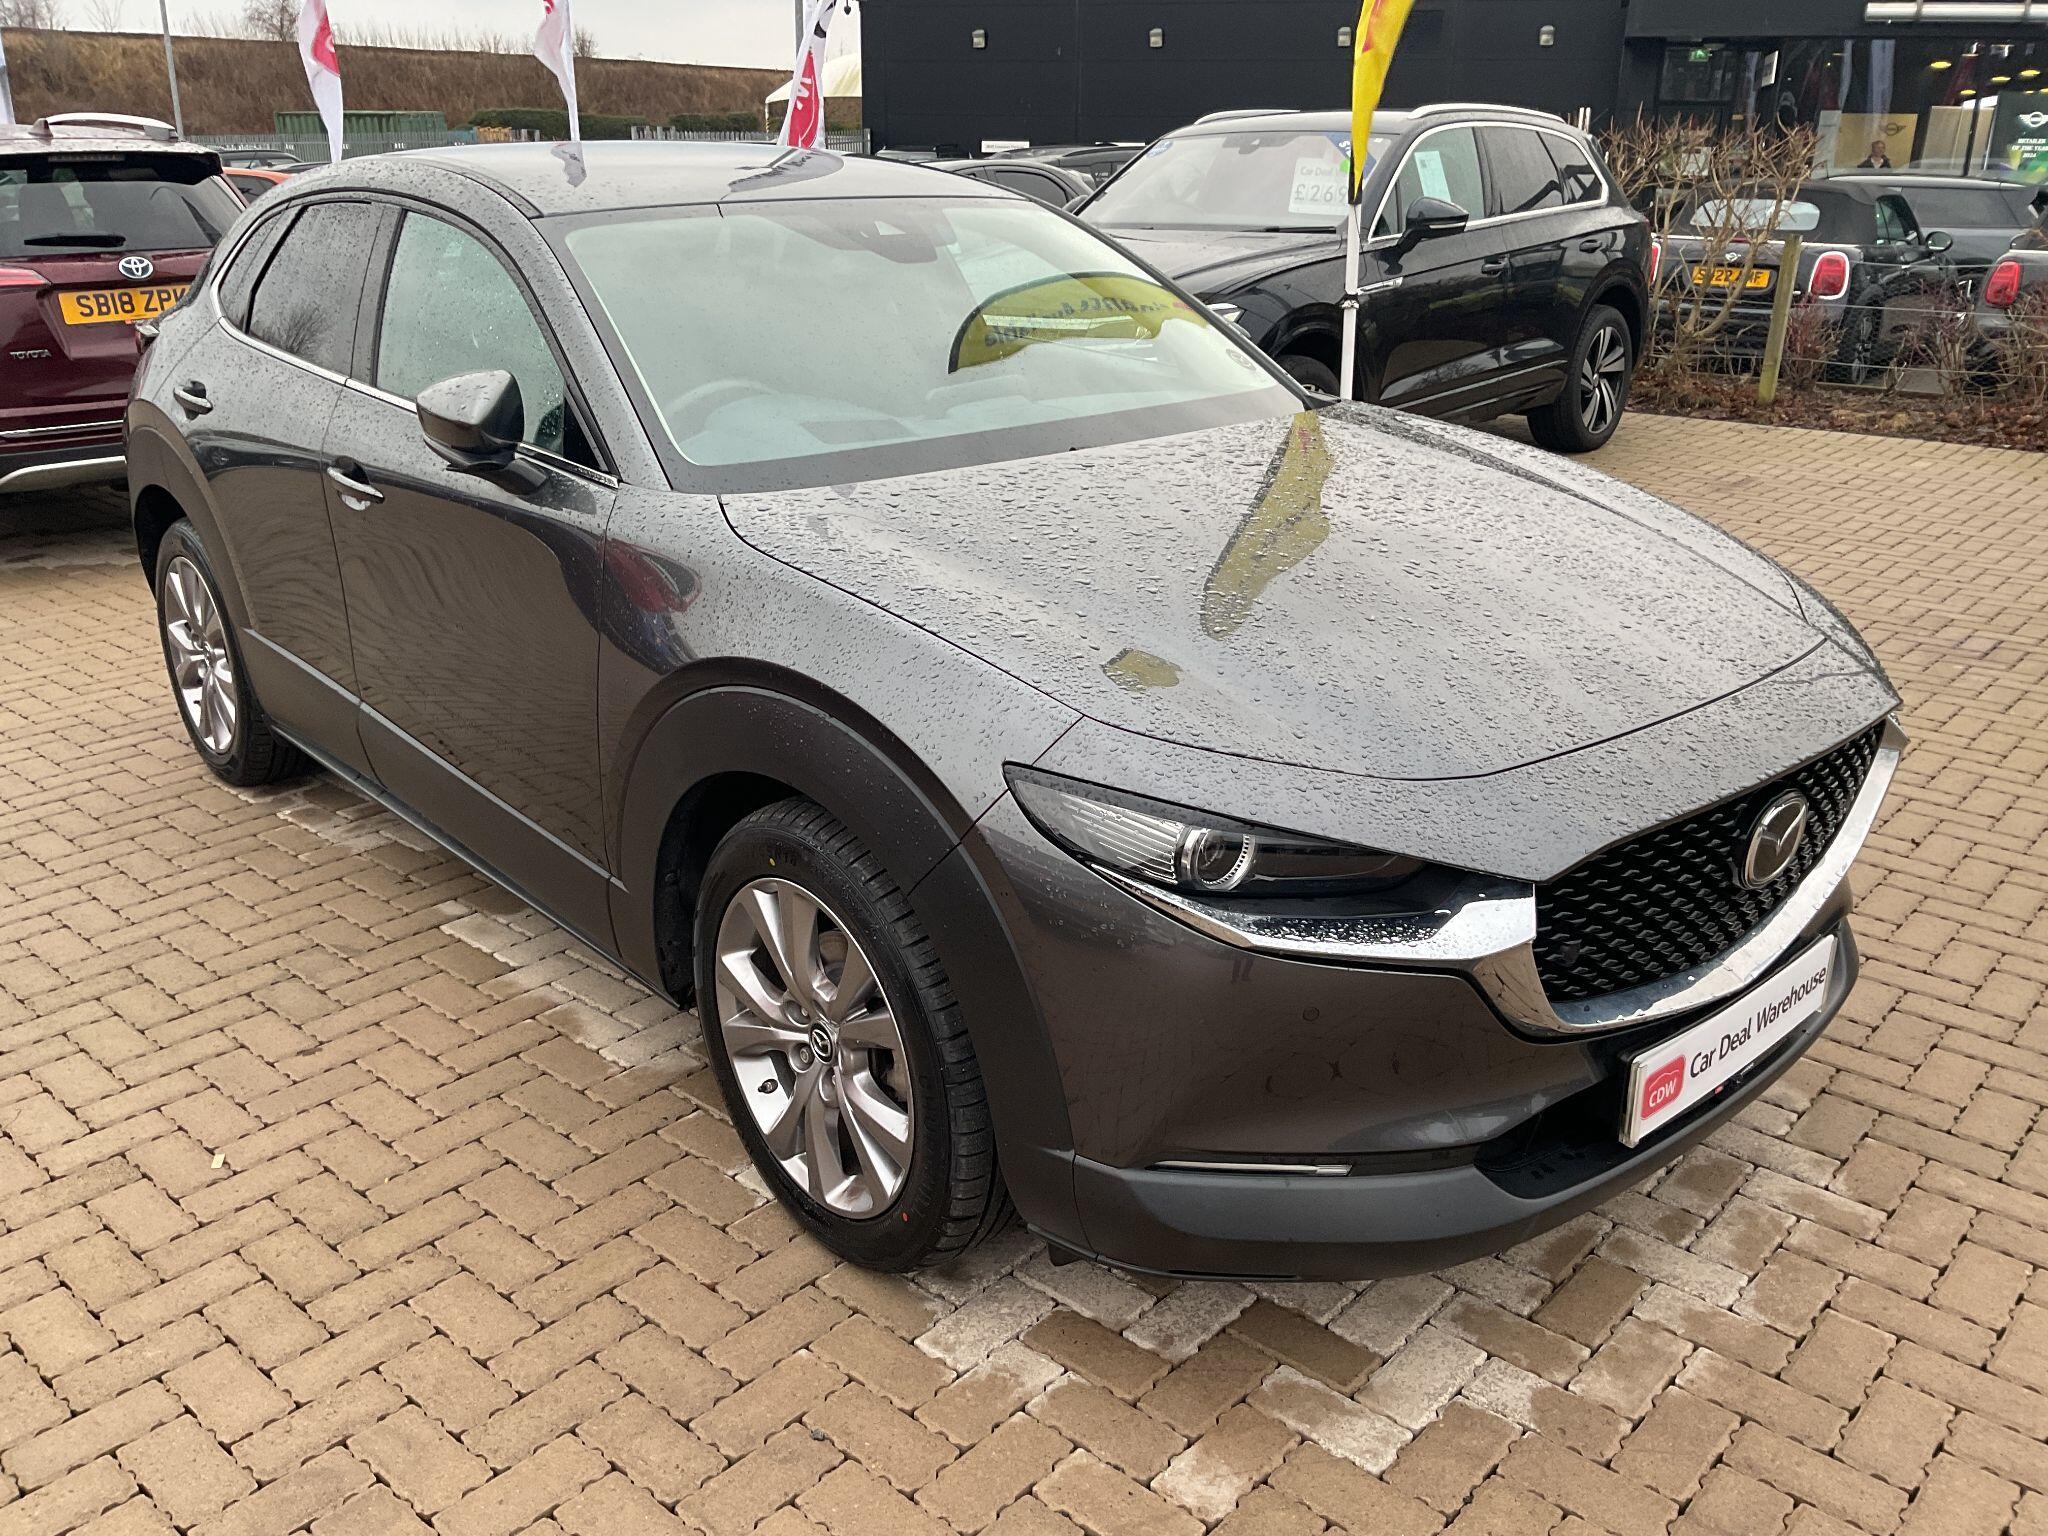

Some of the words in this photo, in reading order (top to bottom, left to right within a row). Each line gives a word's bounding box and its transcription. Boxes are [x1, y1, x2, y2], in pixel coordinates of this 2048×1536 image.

[75, 291, 136, 318] SB18
[9, 349, 52, 360] TOYOTA
[1689, 1047, 1716, 1078] Car
[1718, 1018, 1752, 1061] Deal
[1756, 966, 1827, 1033] Warehouse
[1650, 1077, 1677, 1107] CDW
